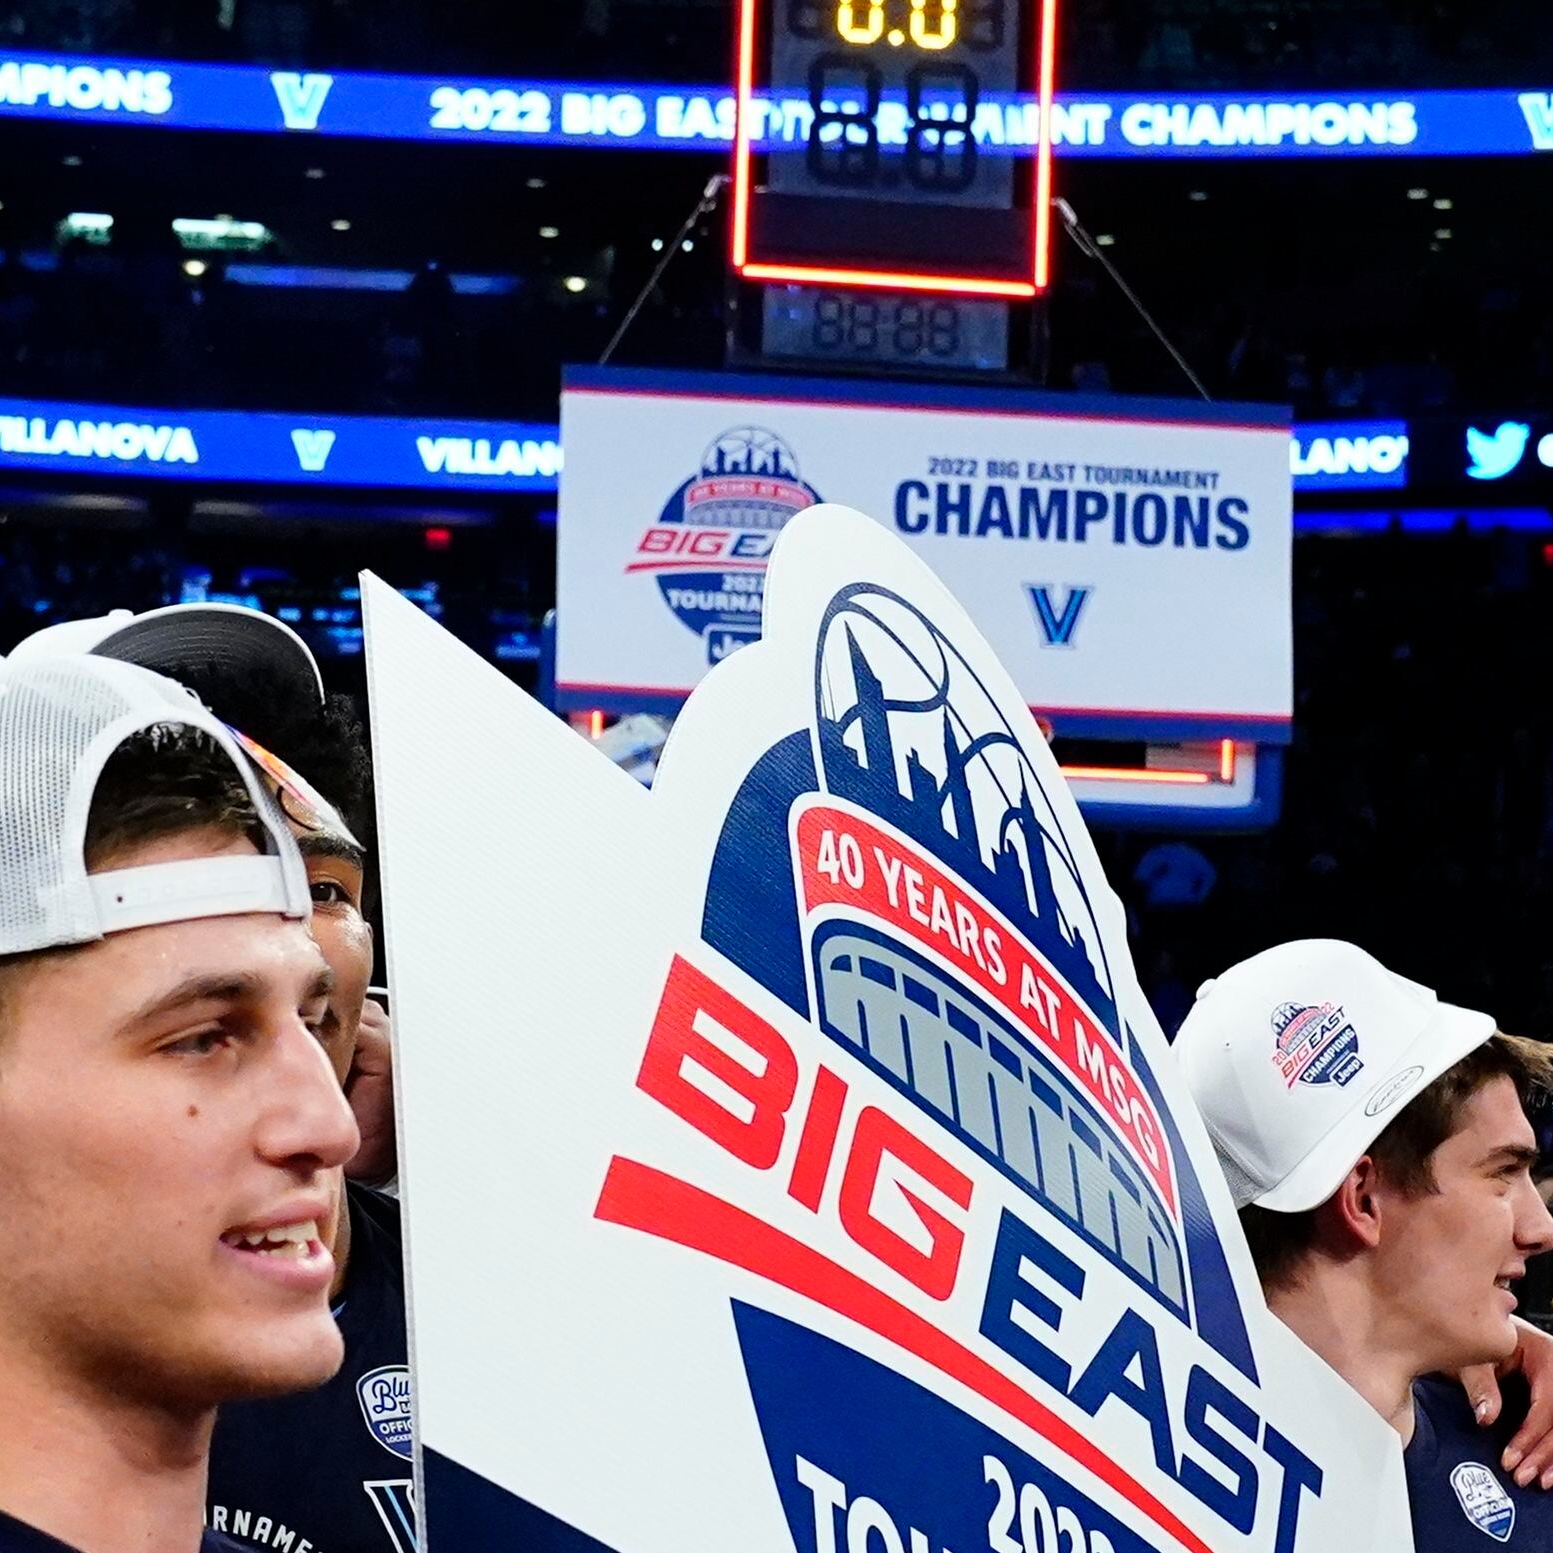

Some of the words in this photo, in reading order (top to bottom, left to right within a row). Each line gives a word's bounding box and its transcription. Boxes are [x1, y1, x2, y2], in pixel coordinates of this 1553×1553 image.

[271, 72, 333, 130] V
[429, 86, 552, 134] 2022
[562, 94, 645, 137] BIG
[1121, 101, 1417, 146] CHAMPIONS
[291, 429, 336, 472] V
[928, 457, 979, 479] 2022
[986, 460, 1020, 480] BIG
[1027, 462, 1076, 484] EAST
[1084, 464, 1221, 490] TOURNAMENT
[1289, 436, 1409, 475] LANO
[636, 527, 731, 557] BIG
[894, 479, 1251, 552] CHAMPIONS
[1022, 581, 1095, 650] V
[816, 829, 866, 892] 40
[877, 854, 1008, 988] YEARS
[1017, 957, 1063, 1040] AT
[1075, 1020, 1163, 1173] MSG
[1281, 1042, 1311, 1079] BIG
[1308, 1004, 1348, 1050] EAST
[1302, 1027, 1356, 1083] CHAMPIONS
[634, 951, 975, 1303] BIG
